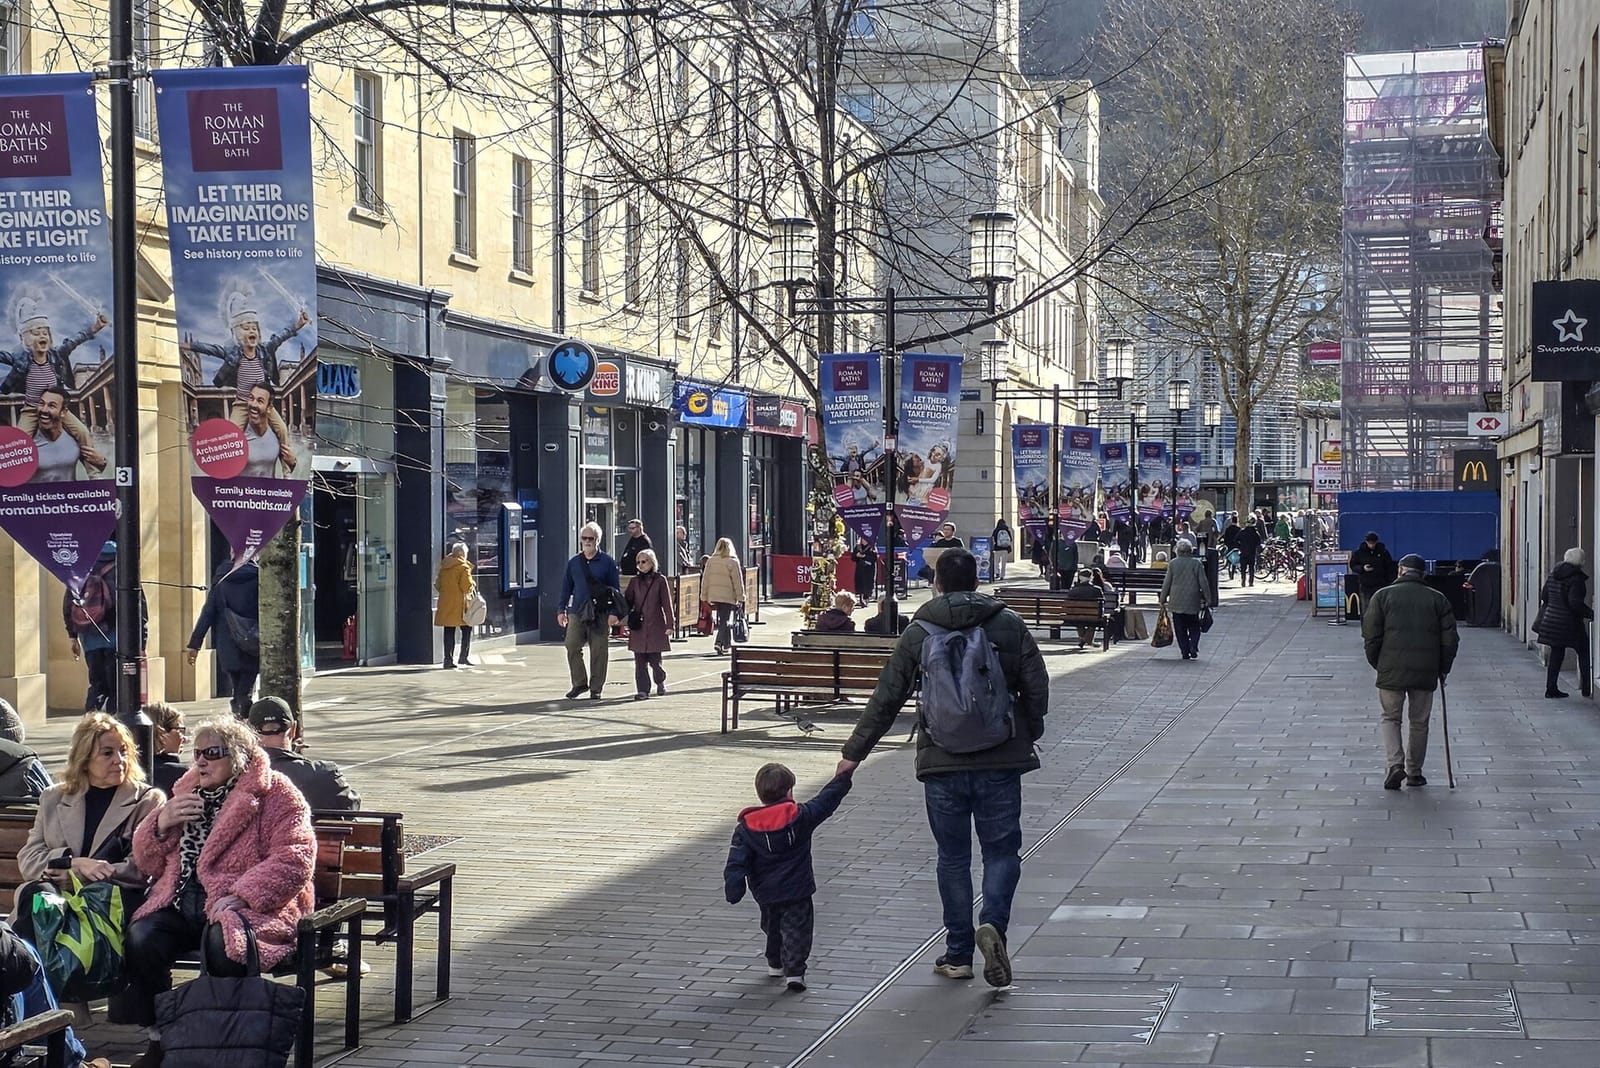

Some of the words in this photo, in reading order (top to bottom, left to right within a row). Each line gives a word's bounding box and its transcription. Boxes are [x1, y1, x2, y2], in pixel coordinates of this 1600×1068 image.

[223, 103, 243, 112] THE
[11, 110, 31, 119] THE
[204, 114, 265, 130] ROMAN
[212, 130, 260, 145] BATHS
[0, 137, 48, 152] BATHS
[12, 155, 38, 164] BATH
[224, 148, 250, 158] BATH
[0, 191, 17, 208] ET
[20, 190, 72, 208] THEIR
[198, 185, 228, 203] LET
[231, 183, 283, 202] THEIR
[0, 208, 102, 228] GINATIONS
[171, 203, 310, 224] IMAGINATIONS
[0, 231, 22, 248] KE
[25, 229, 89, 247] FLIGHT
[187, 225, 233, 243] TAKE
[236, 224, 297, 242] FLIGHT
[34, 254, 65, 264] come
[66, 253, 78, 262] to
[79, 252, 97, 262] life
[183, 249, 204, 260] See
[206, 248, 242, 260] history
[244, 248, 274, 258] come
[275, 247, 287, 258] to
[288, 247, 303, 258] life
[1537, 345, 1600, 354] Superdrug
[317, 362, 361, 396] CLAYS
[591, 380, 619, 389] KING
[921, 376, 941, 384] BATHS
[835, 395, 847, 403] LET
[848, 394, 869, 402] THEIR
[913, 395, 926, 403] LET
[927, 397, 947, 405] THEIR
[824, 401, 880, 411] IMAGINATIONS
[902, 402, 958, 414] IMAGINATIONS
[830, 410, 849, 418] TAKE
[849, 409, 874, 417] FLIGHT
[907, 410, 925, 418] TAKE
[926, 411, 951, 420] FLIGHT
[0, 446, 33, 460] aeology
[196, 439, 244, 456] Archaeology
[0, 455, 34, 470] ventures
[201, 448, 244, 464] Adventures
[118, 470, 129, 483] 3
[2, 494, 34, 503] Family
[35, 491, 66, 501] tickets
[67, 489, 111, 499] available
[214, 486, 244, 497] Family
[244, 487, 267, 496] tickets
[267, 488, 293, 498] available
[0, 500, 117, 517] romanbaths.co.uk
[212, 499, 293, 512] romanbaths.co.uk
[797, 574, 811, 583] BU
